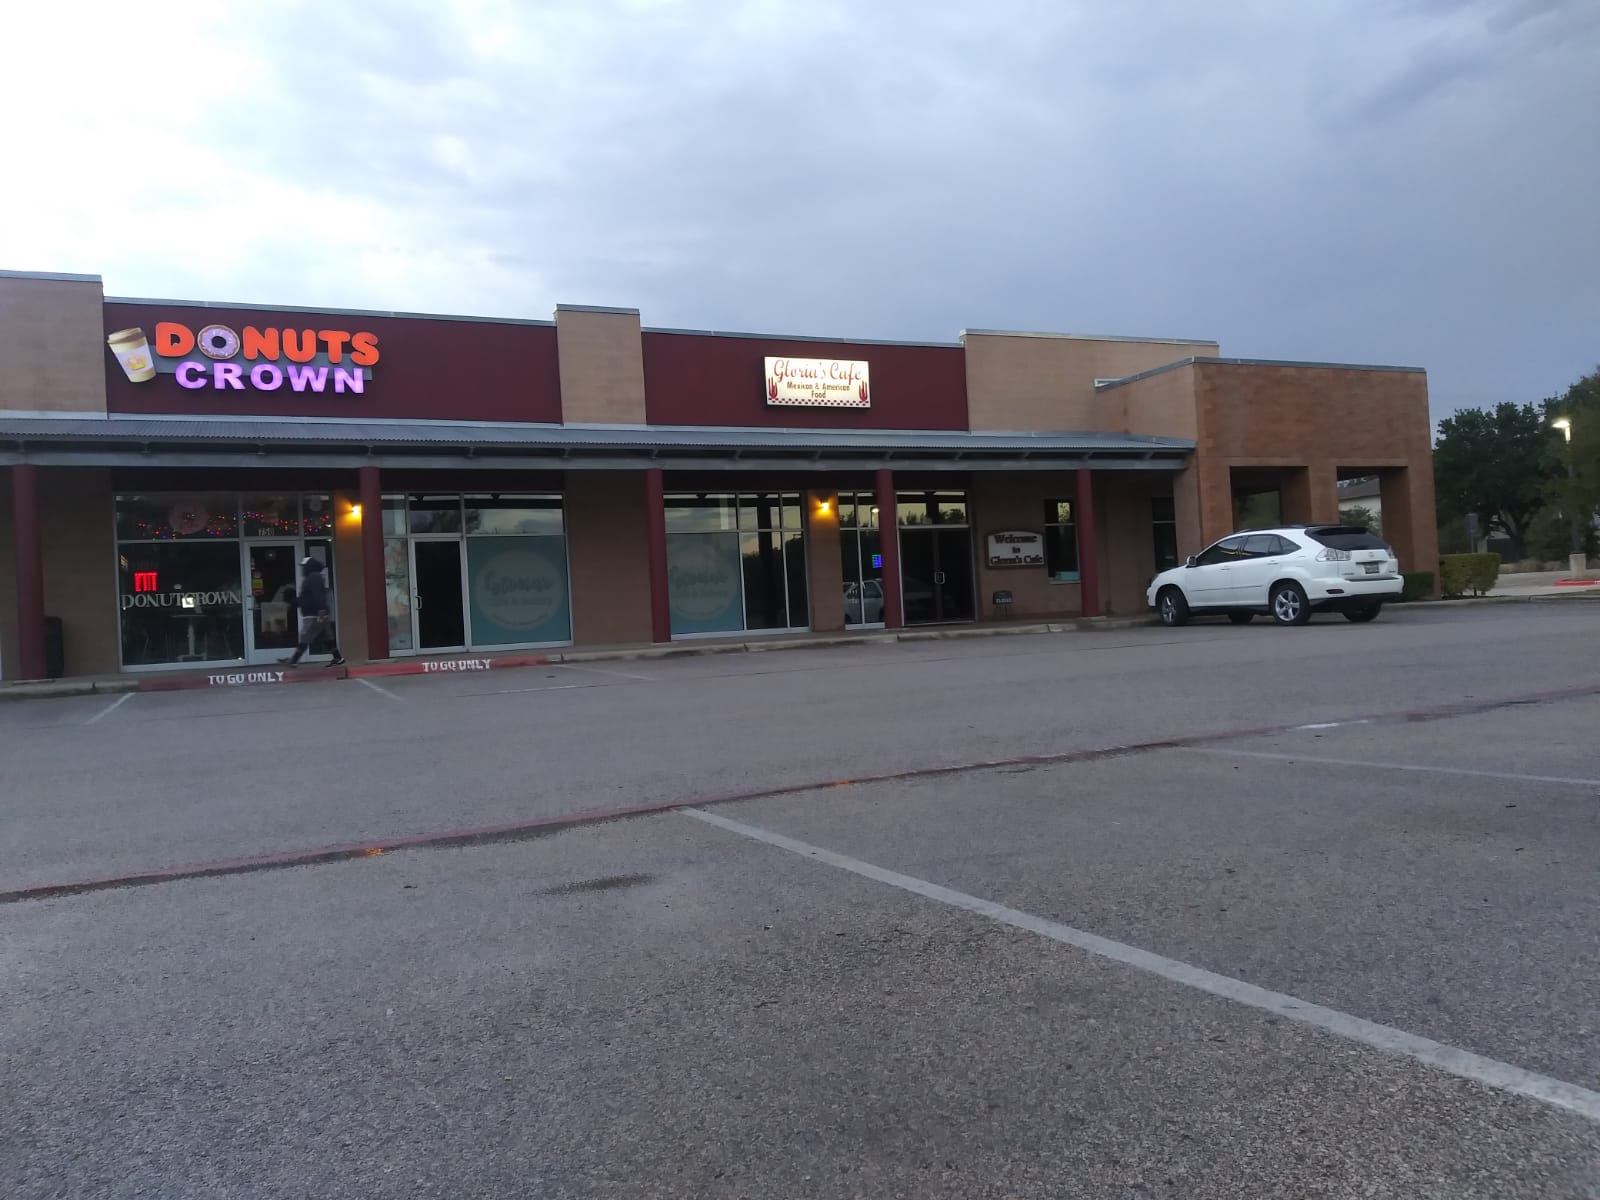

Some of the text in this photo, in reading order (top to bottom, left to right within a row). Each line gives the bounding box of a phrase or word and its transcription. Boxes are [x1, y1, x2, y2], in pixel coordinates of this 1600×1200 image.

[155, 322, 380, 366] DONUTS
[175, 361, 365, 394] CROWN
[774, 360, 861, 385] Gloria's Cafe
[815, 382, 820, 390] &
[822, 383, 851, 391] American
[811, 390, 826, 399] Food
[421, 658, 492, 673] TO GO ONLY
[207, 671, 285, 685] TO GO ONLY
